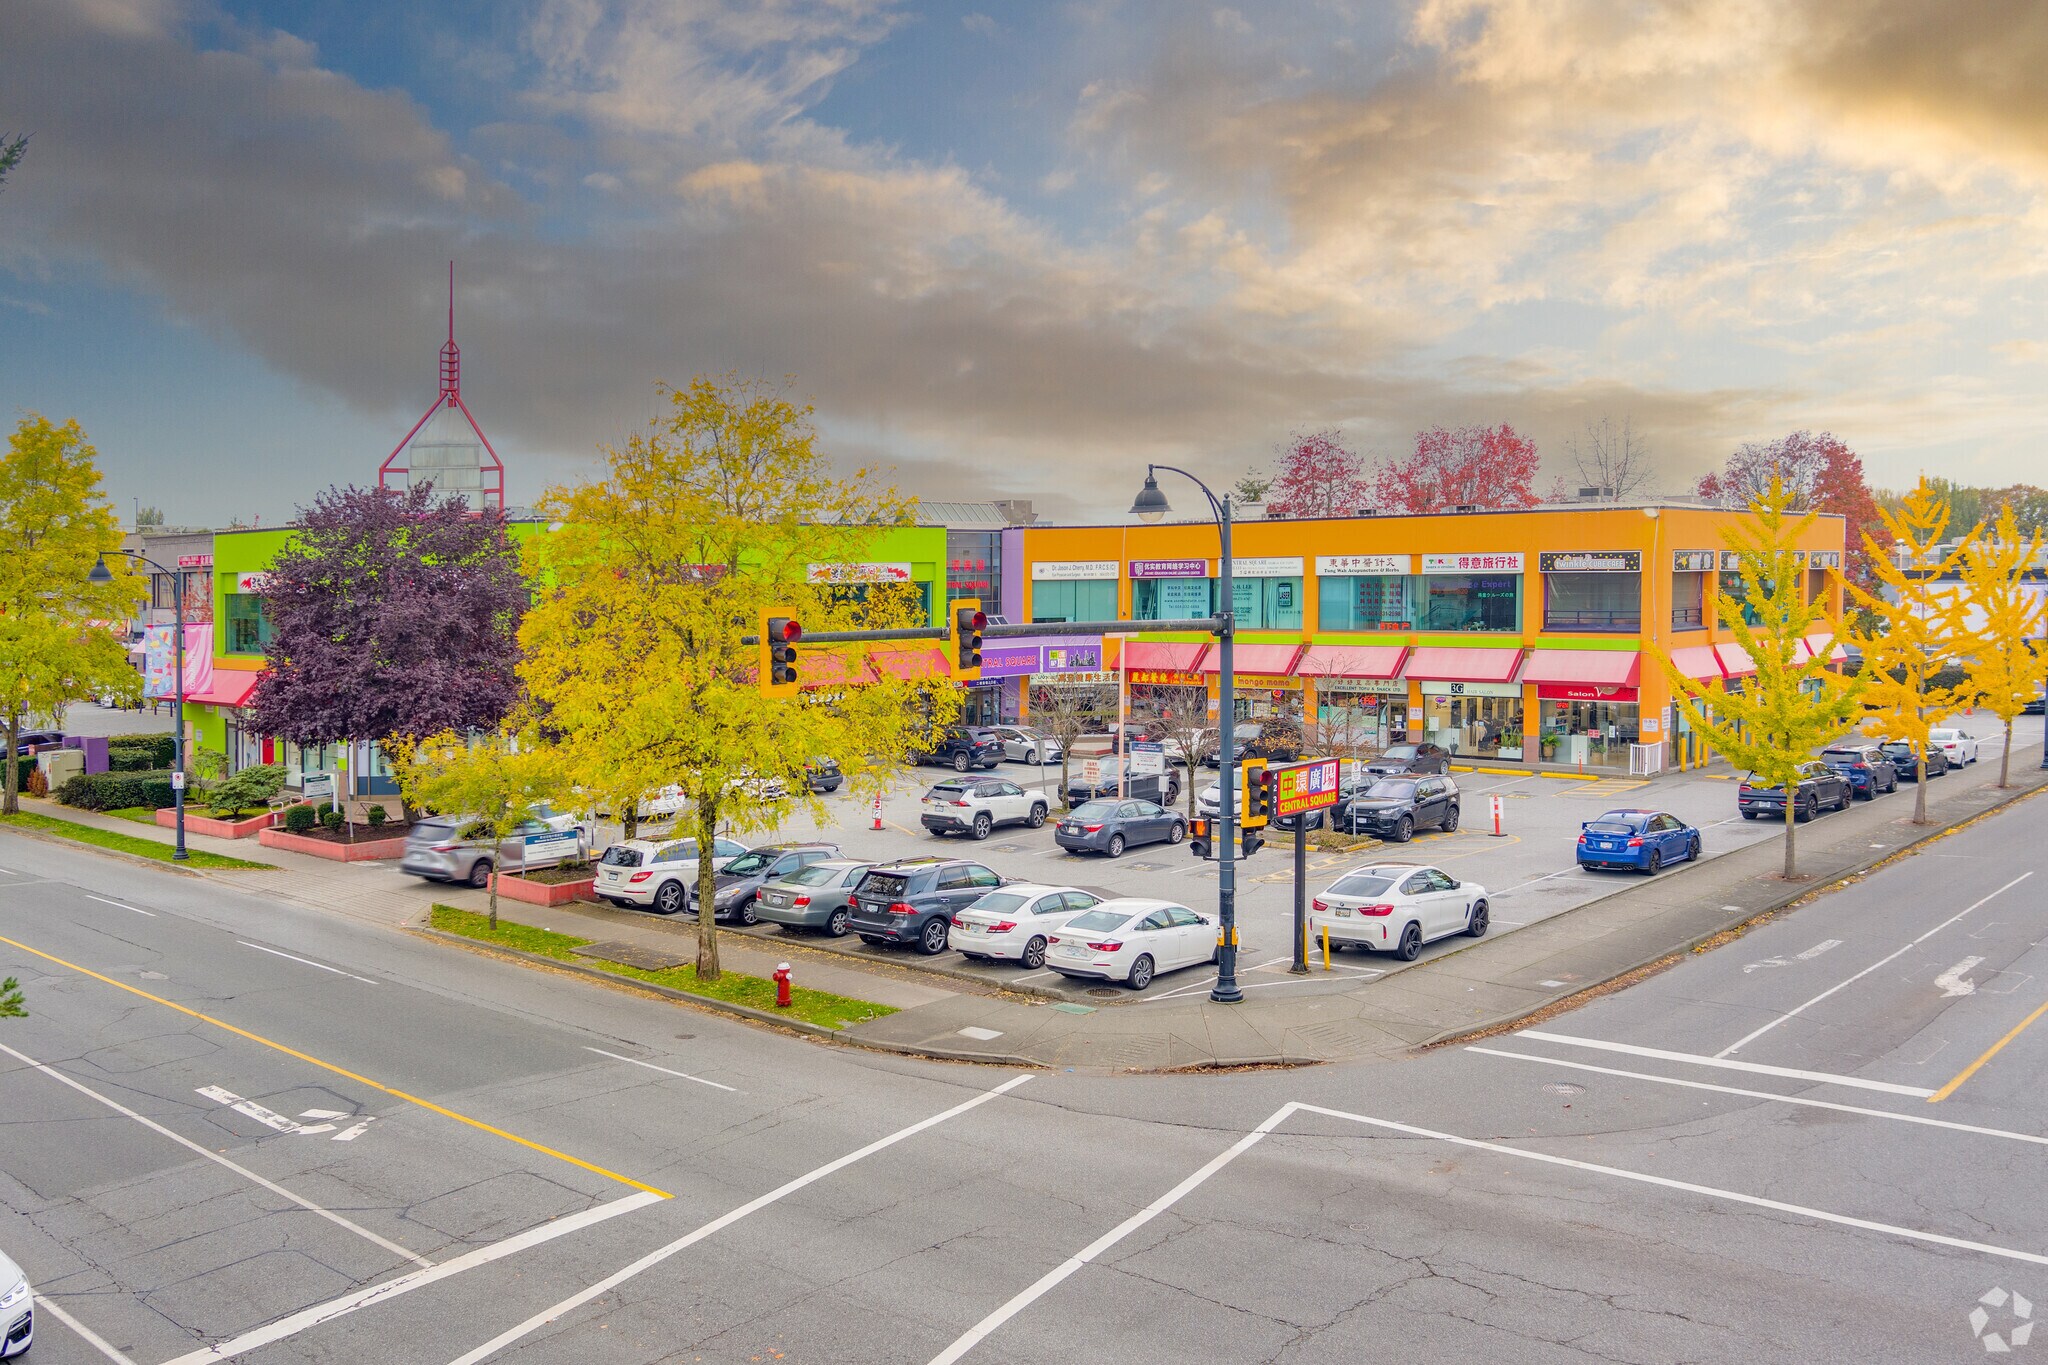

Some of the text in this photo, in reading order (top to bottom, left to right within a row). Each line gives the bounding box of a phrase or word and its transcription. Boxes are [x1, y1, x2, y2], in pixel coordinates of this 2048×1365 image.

[1458, 556, 1518, 569] 得意旅行社
[1555, 558, 1587, 568] twinkle
[1481, 580, 1511, 589] Expert
[1005, 655, 1037, 667] SQUARE
[1238, 677, 1264, 687] mango
[1451, 683, 1464, 694] 3G
[1283, 763, 1336, 796] 中環廣場
[1280, 792, 1336, 813] CENTRAL SQUARE
